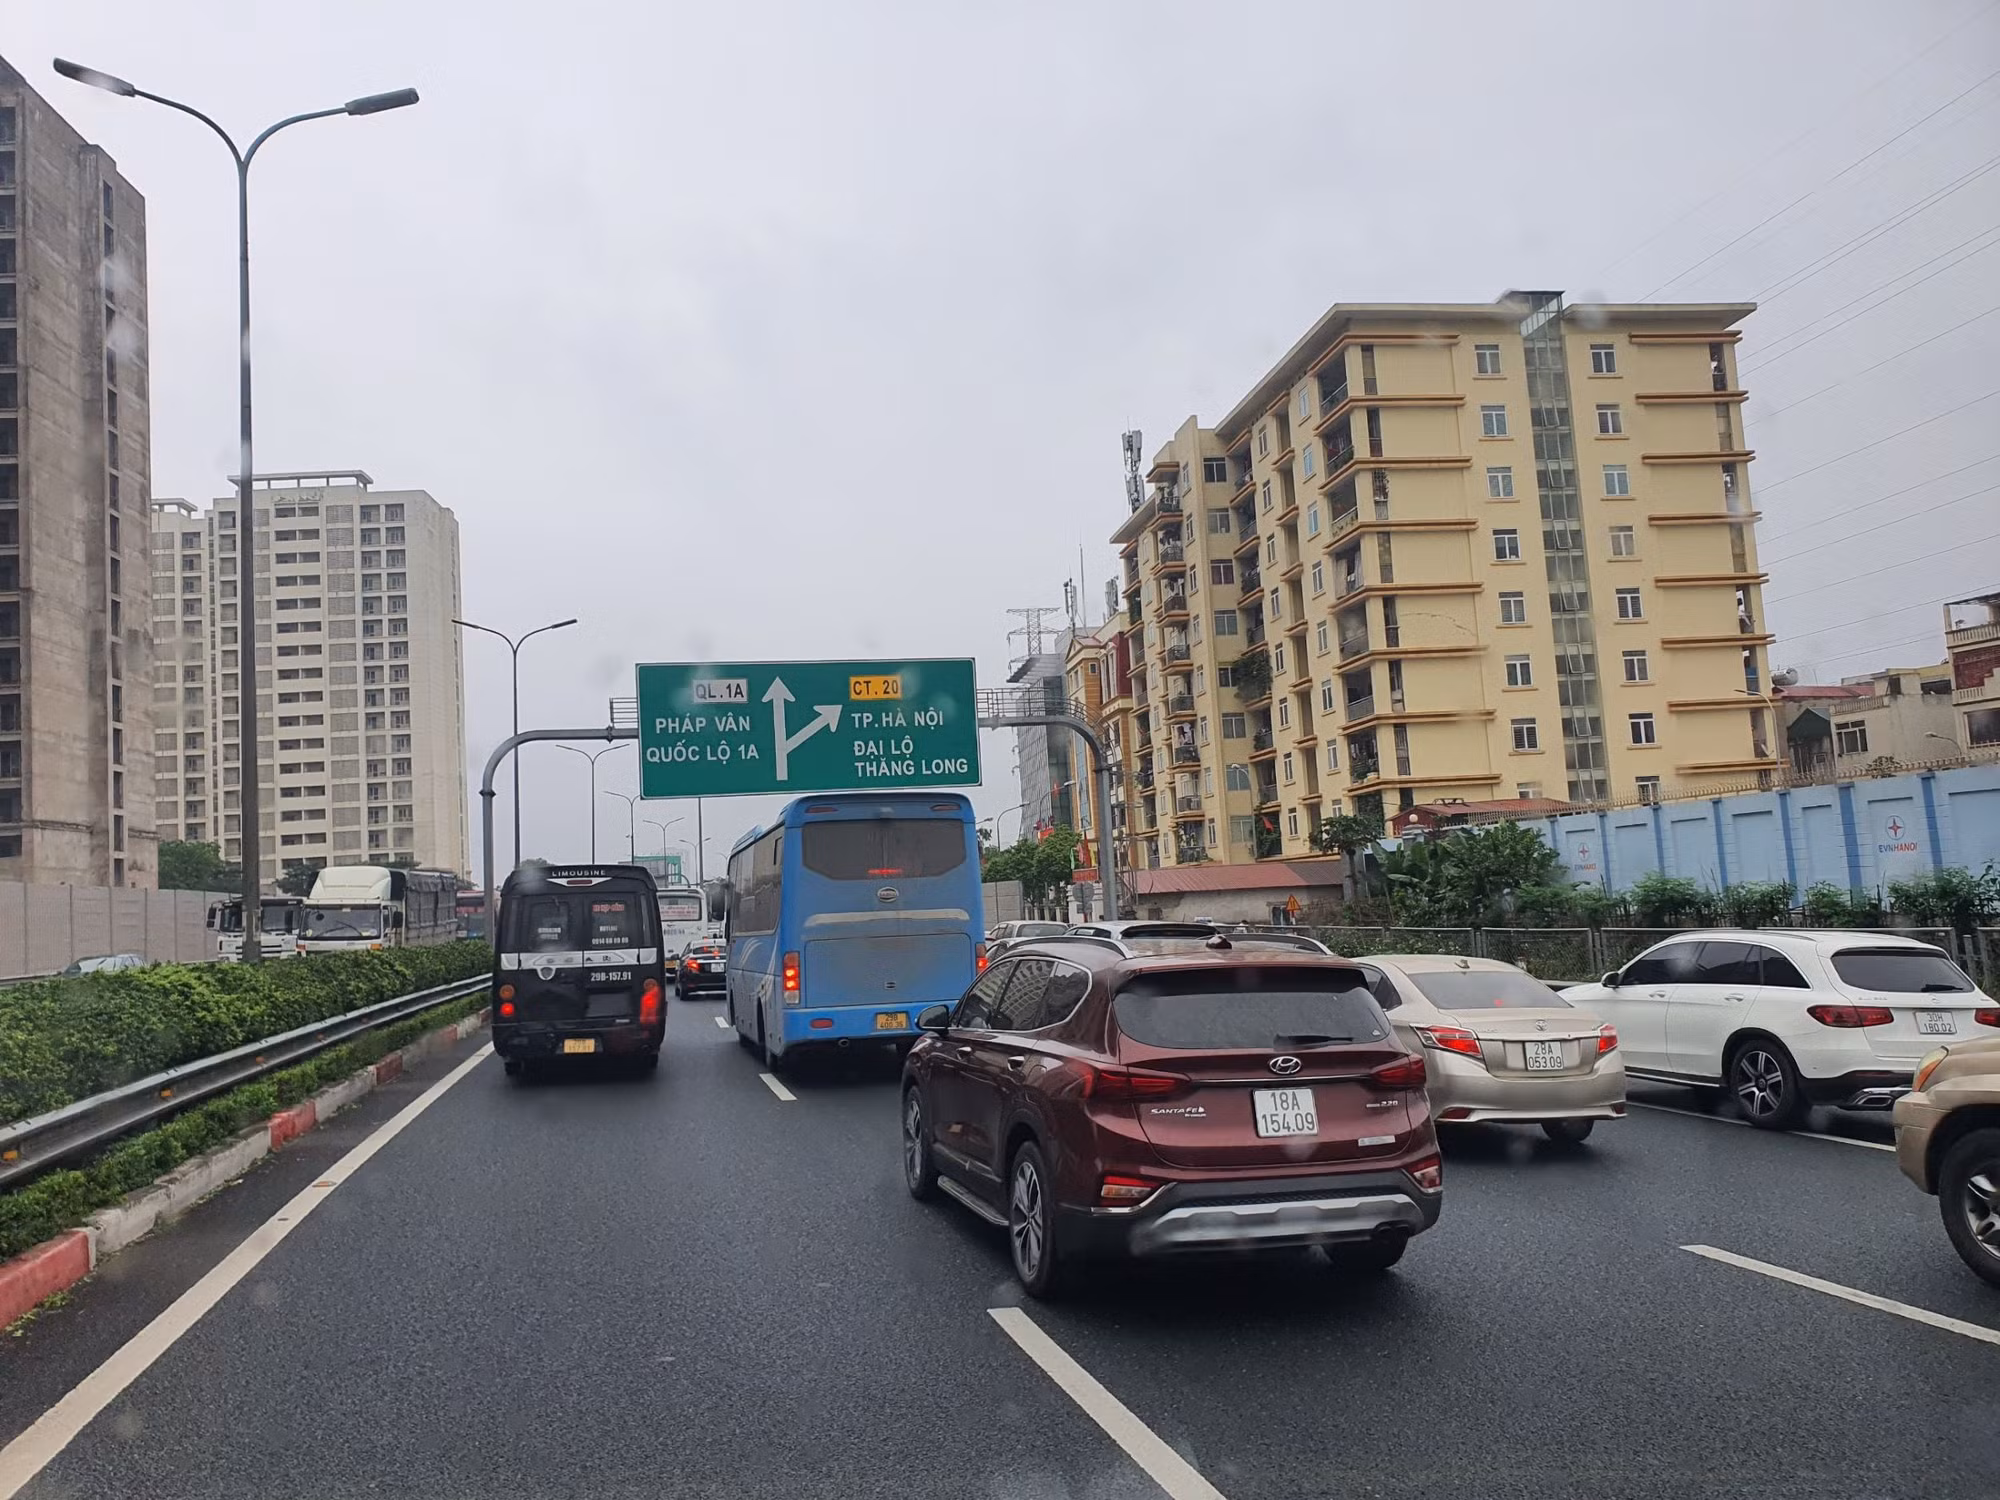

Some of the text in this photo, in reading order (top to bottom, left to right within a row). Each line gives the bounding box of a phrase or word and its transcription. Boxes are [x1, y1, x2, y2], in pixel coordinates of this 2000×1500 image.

[696, 683, 744, 700] QL.1A
[853, 679, 899, 696] CT.20
[655, 712, 751, 734] PHÁP VÂN
[914, 707, 943, 730] NỘI
[646, 739, 760, 765] QUỐC LỘ 1A
[853, 735, 914, 759] ĐẠI LỘ
[854, 757, 968, 777] THĂNG LONG
[1878, 843, 1918, 853] EVNHANOI
[1534, 1042, 1554, 1056] 28A
[1528, 1055, 1562, 1069] 053.09
[1270, 1090, 1301, 1112] 18A
[1261, 1111, 1315, 1134] 154.09
